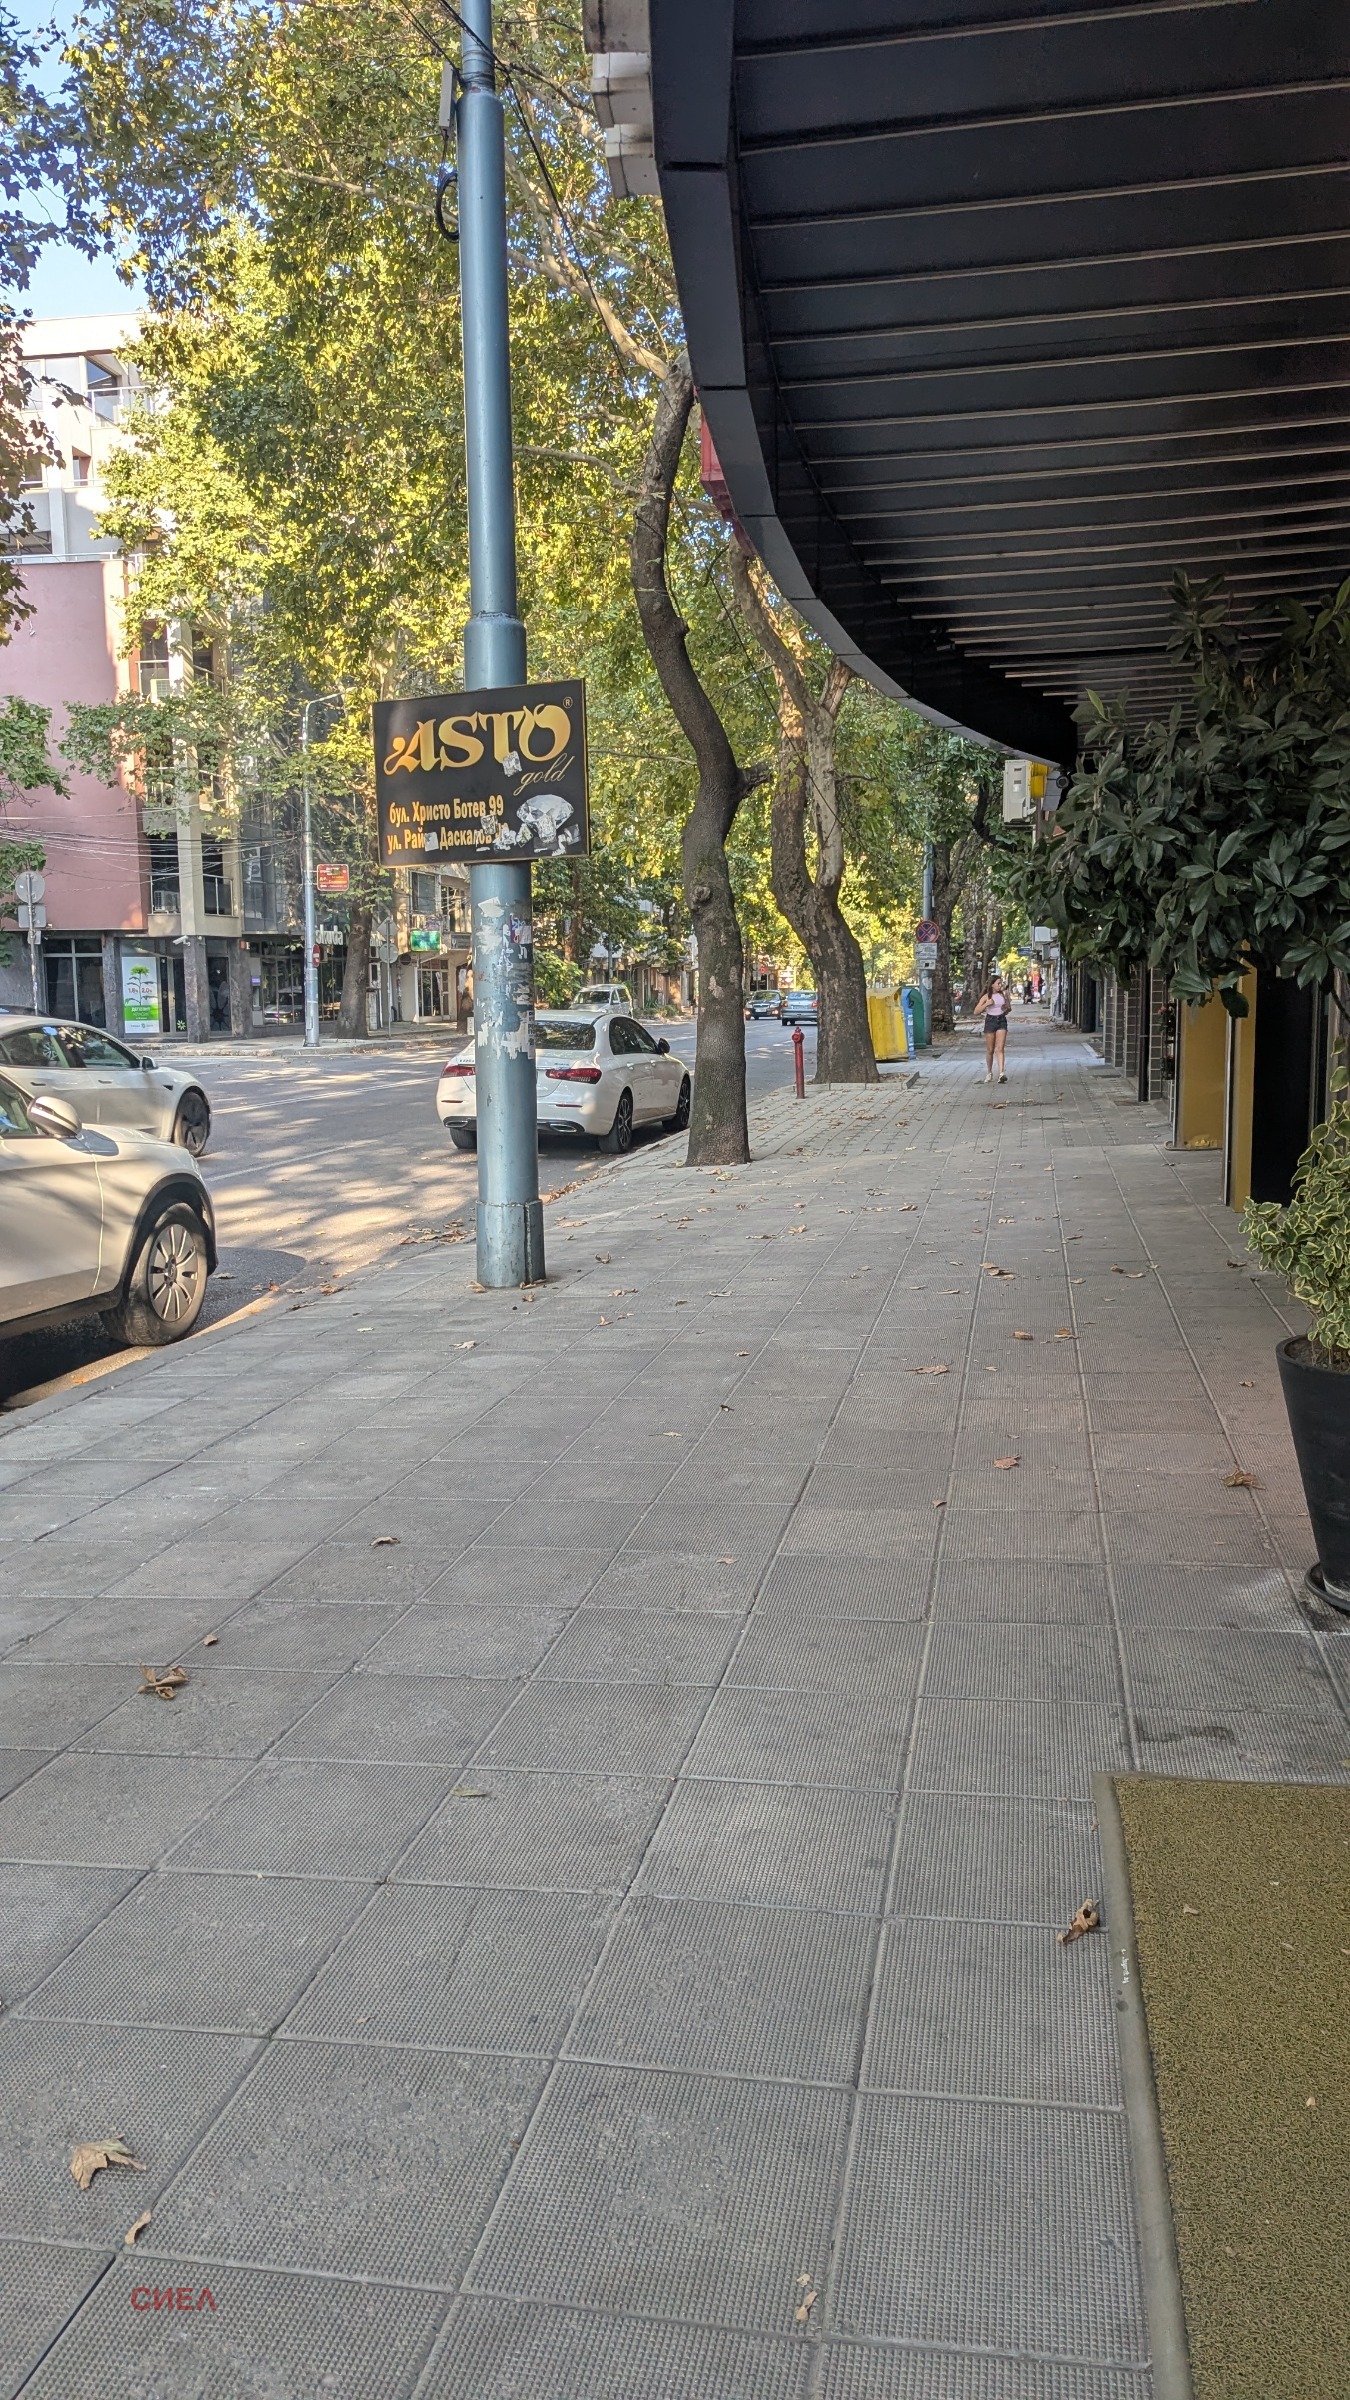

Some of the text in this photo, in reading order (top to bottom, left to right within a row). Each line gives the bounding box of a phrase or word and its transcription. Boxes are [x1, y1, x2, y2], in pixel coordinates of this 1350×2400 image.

[384, 704, 571, 776] ASTO
[513, 752, 575, 796] gold
[389, 794, 504, 828] бул. Христо Ботев 99
[387, 833, 402, 855] ул.
